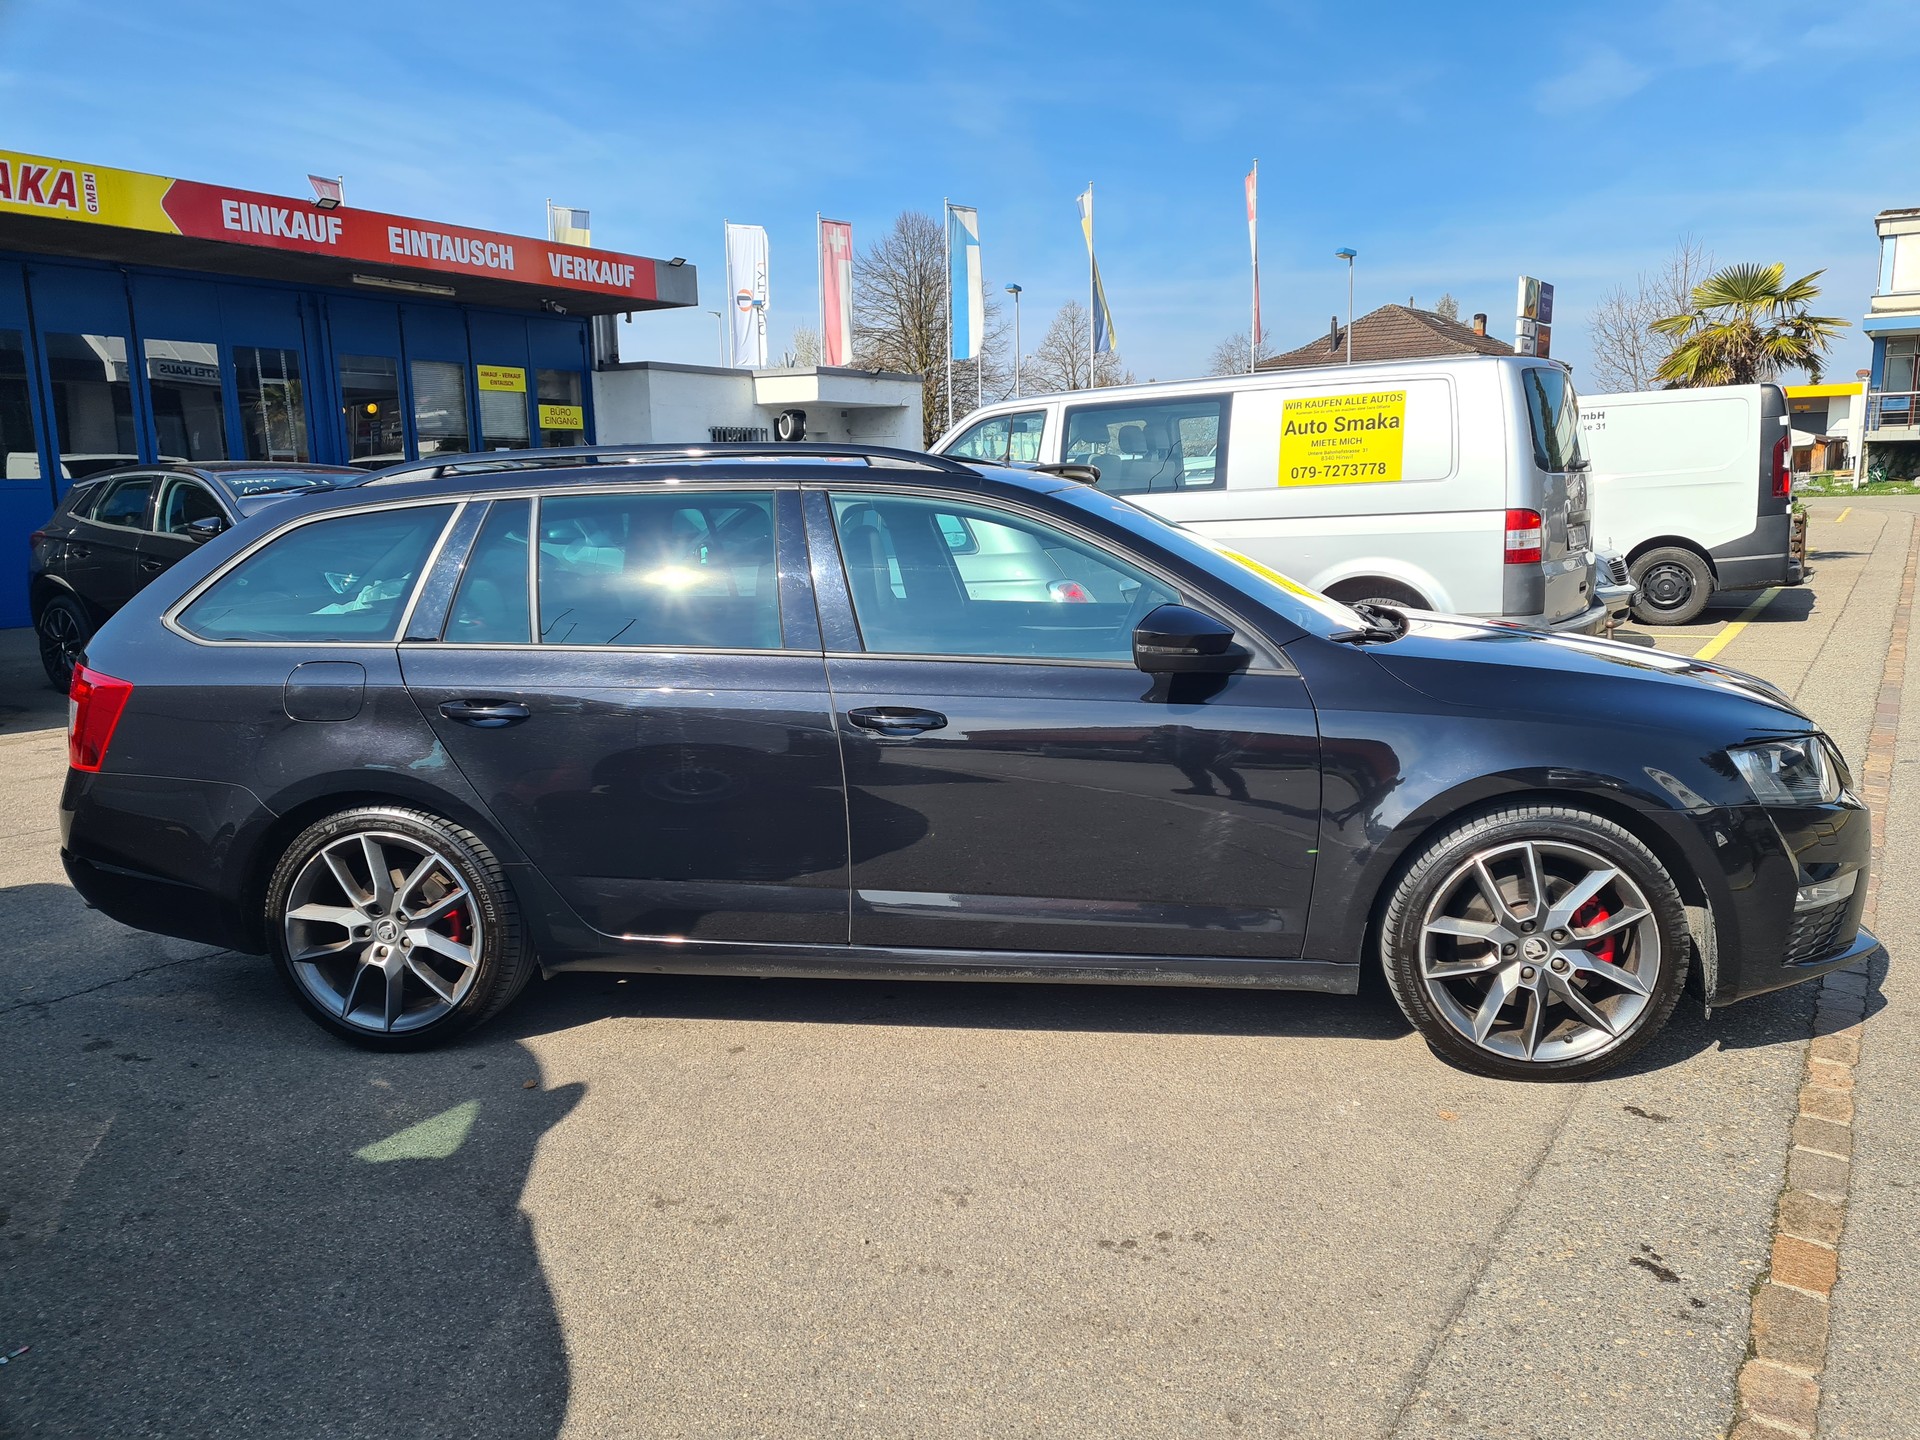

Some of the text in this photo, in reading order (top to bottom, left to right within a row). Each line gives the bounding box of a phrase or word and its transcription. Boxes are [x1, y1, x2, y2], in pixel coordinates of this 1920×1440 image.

[84, 173, 98, 213] GMBH
[222, 200, 635, 288] EINKAUF EINTAUSCH VERKAUF
[502, 372, 522, 380] VERKAUF
[1285, 393, 1403, 410] WIR KAUFEN ALLE AUTOS
[550, 407, 572, 417] BÜRO
[1581, 411, 1605, 420] mbH
[545, 416, 578, 426] EINGANG
[1284, 412, 1400, 436] Auto Smaka
[1595, 422, 1606, 430] 31
[1311, 437, 1363, 447] MIETE MICH
[1291, 462, 1386, 479] 079-7273778
[461, 860, 496, 923] BRIDGESTONE
[1401, 953, 1432, 1021] BRIDGESTONE
